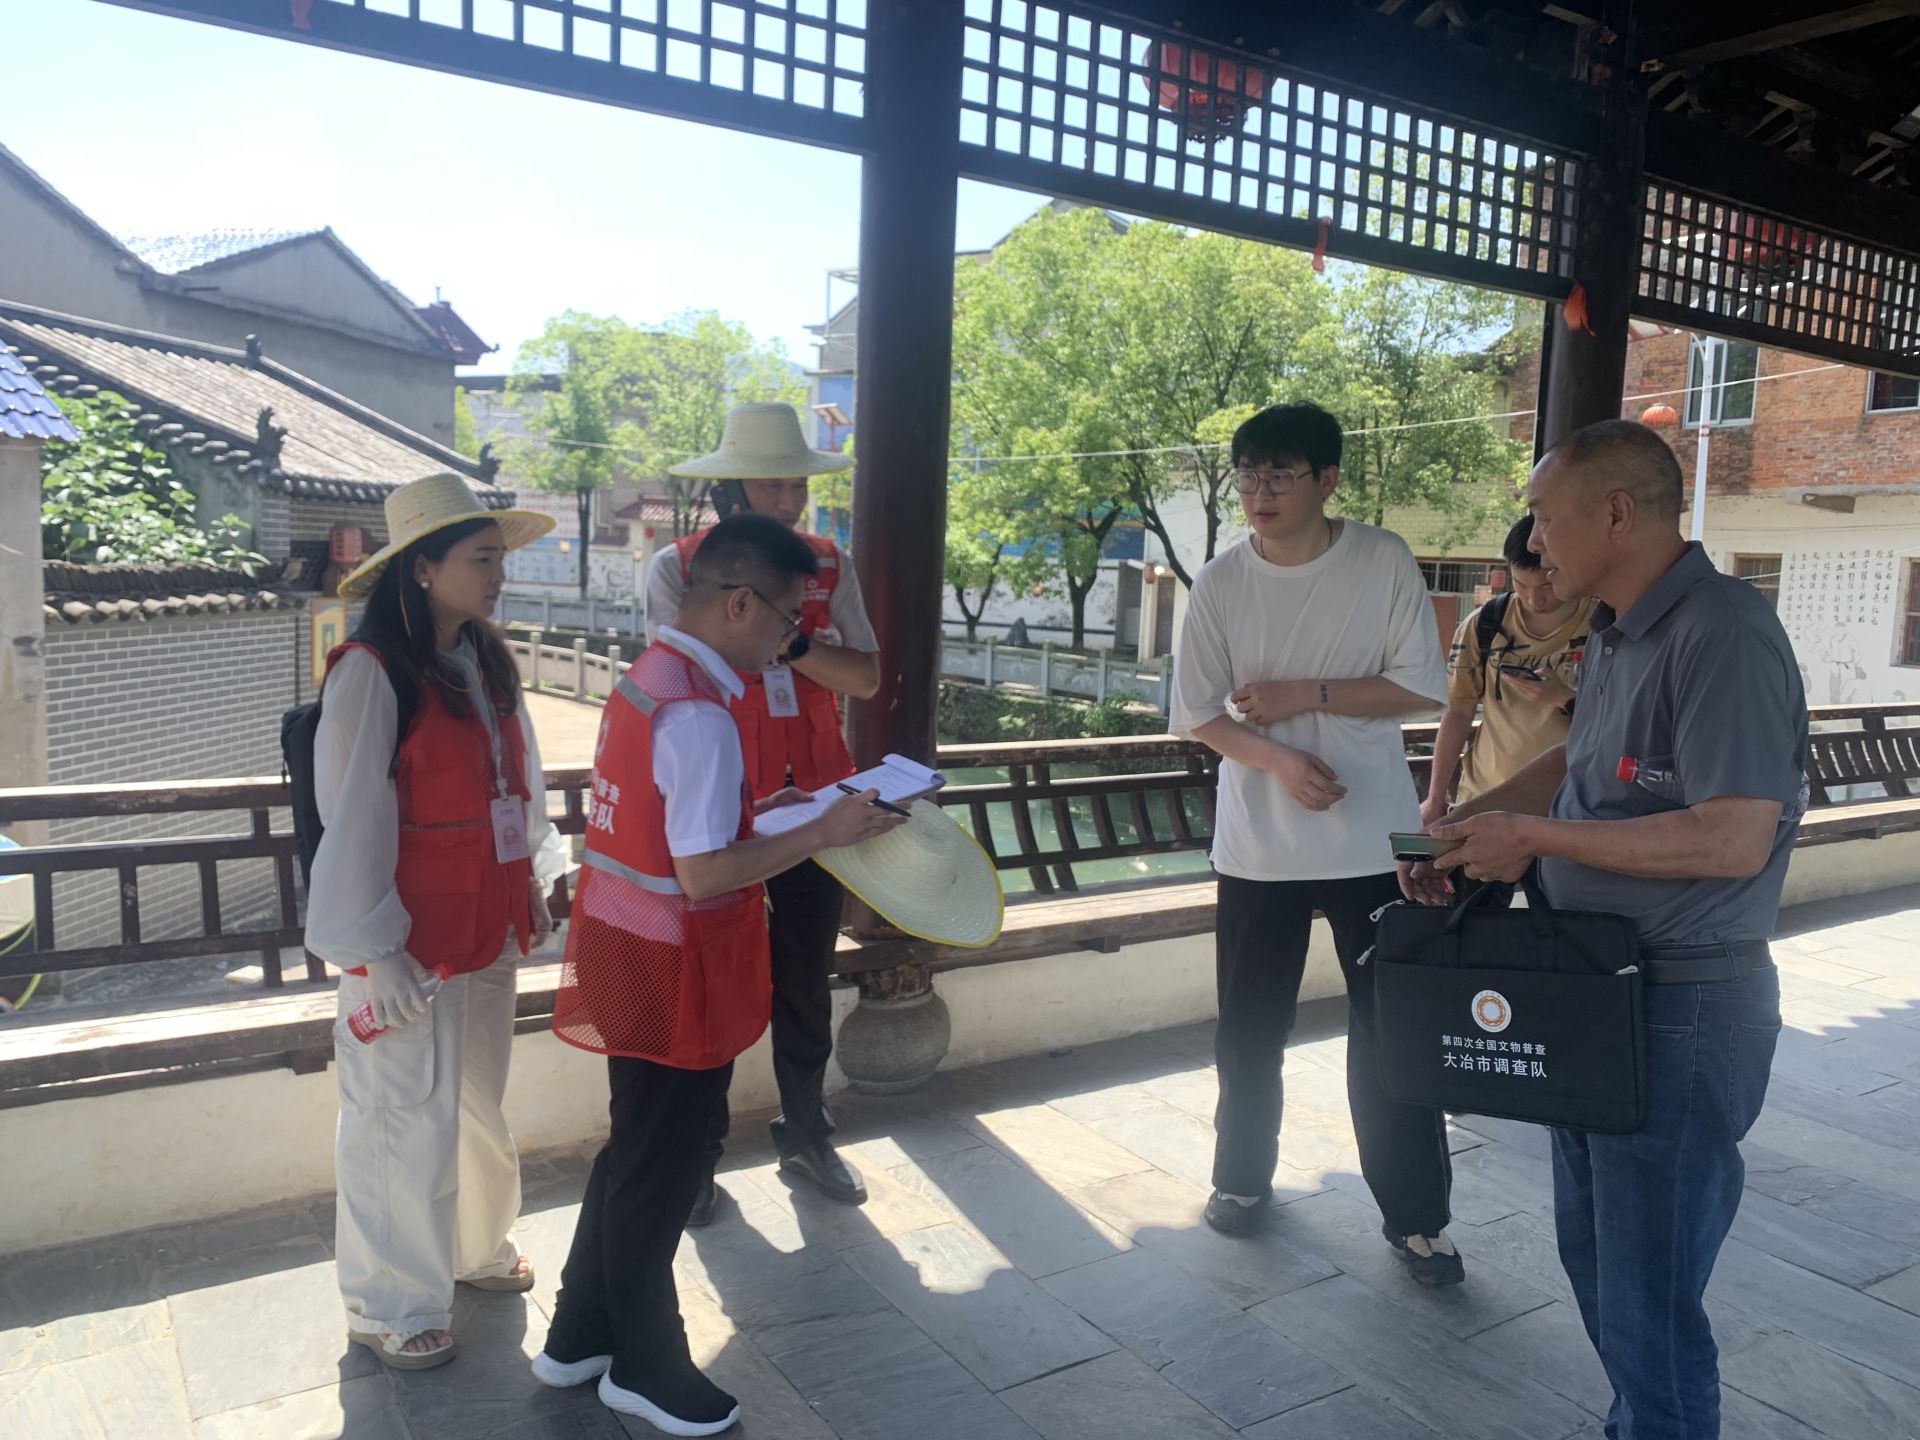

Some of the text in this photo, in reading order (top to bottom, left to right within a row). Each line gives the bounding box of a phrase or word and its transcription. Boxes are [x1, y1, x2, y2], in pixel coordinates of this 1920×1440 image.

[1441, 1034, 1547, 1056] 第四次全国文物普查
[1443, 1052, 1548, 1079] 大冶市调查队
